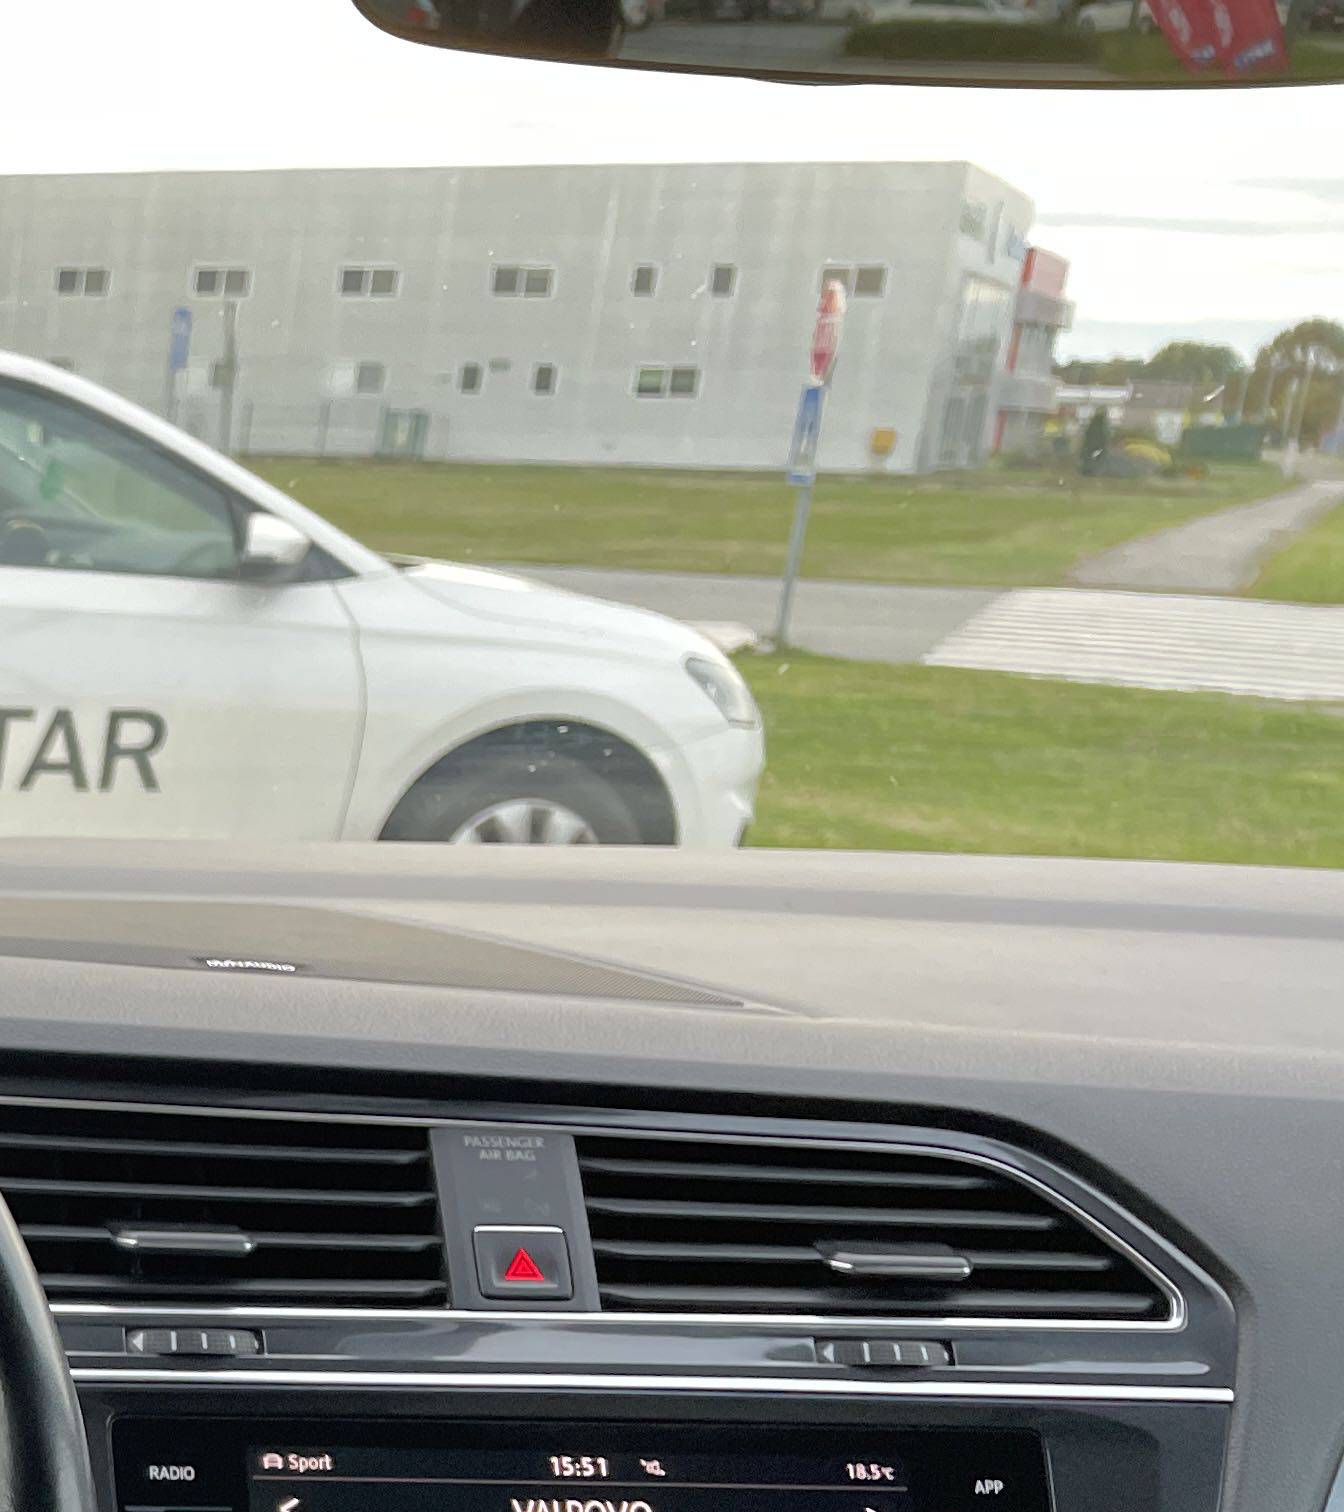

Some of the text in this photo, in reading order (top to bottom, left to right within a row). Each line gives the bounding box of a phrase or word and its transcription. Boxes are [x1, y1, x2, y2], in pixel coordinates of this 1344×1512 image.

[464, 1136, 545, 1148] PASSENGER
[479, 1150, 537, 1162] AIR BAG
[287, 1454, 333, 1473] Sport
[548, 1455, 608, 1478] 15:51
[148, 1465, 196, 1482] RADIO
[973, 1479, 1004, 1495] APP
